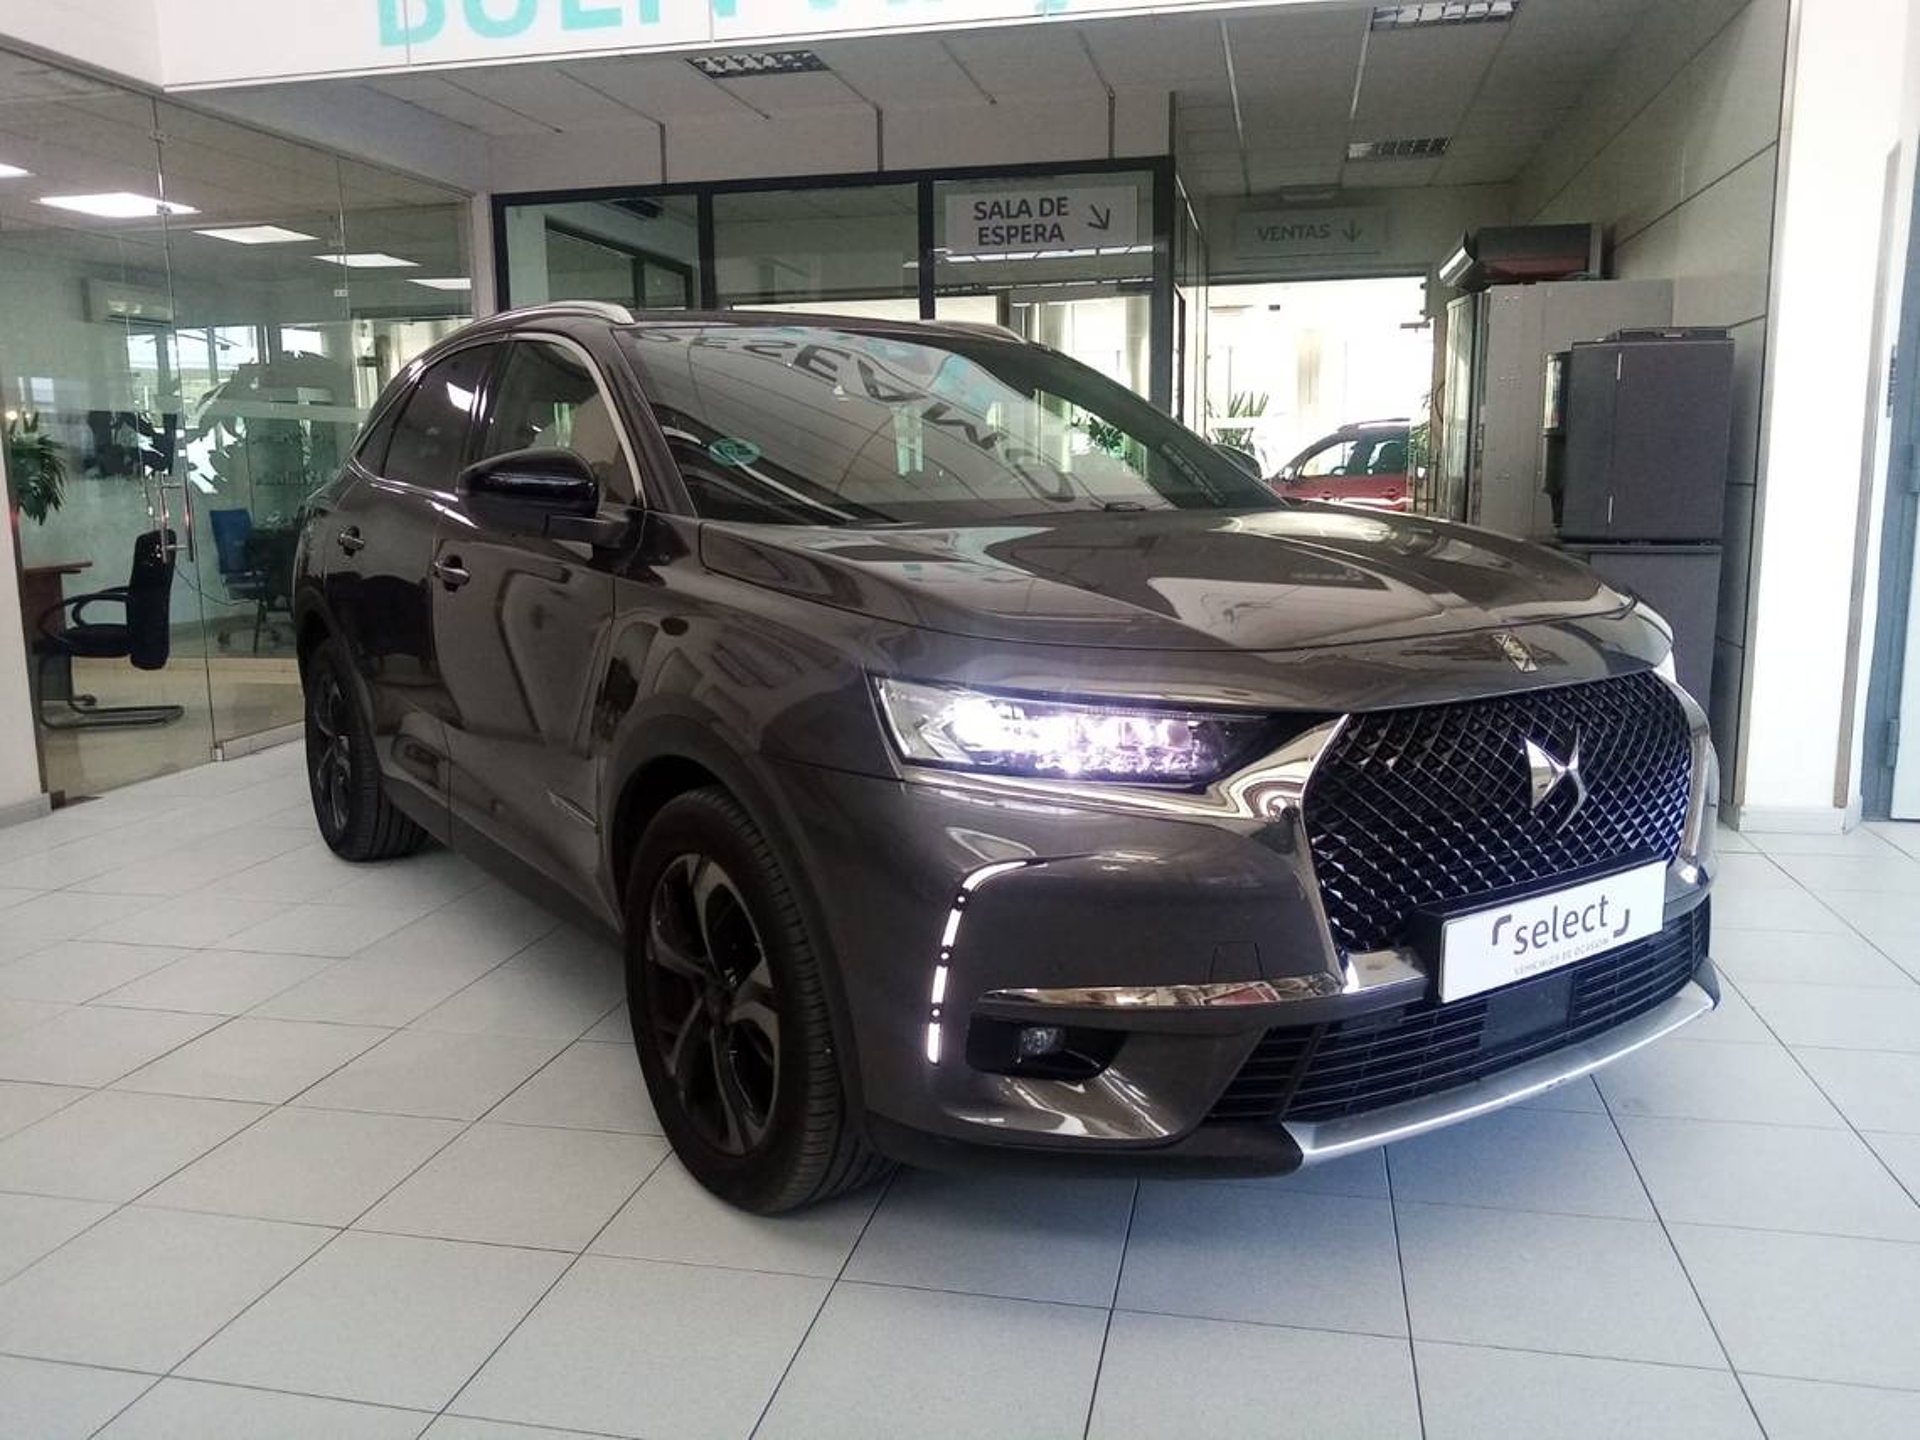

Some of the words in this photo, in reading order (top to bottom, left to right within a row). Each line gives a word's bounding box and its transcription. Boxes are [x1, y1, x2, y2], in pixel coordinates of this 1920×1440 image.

[974, 198, 1033, 221] SALA
[1039, 196, 1070, 218] DE
[978, 222, 1065, 246] ESPERA
[1252, 223, 1332, 243] VENTAS
[1513, 894, 1609, 956] select
